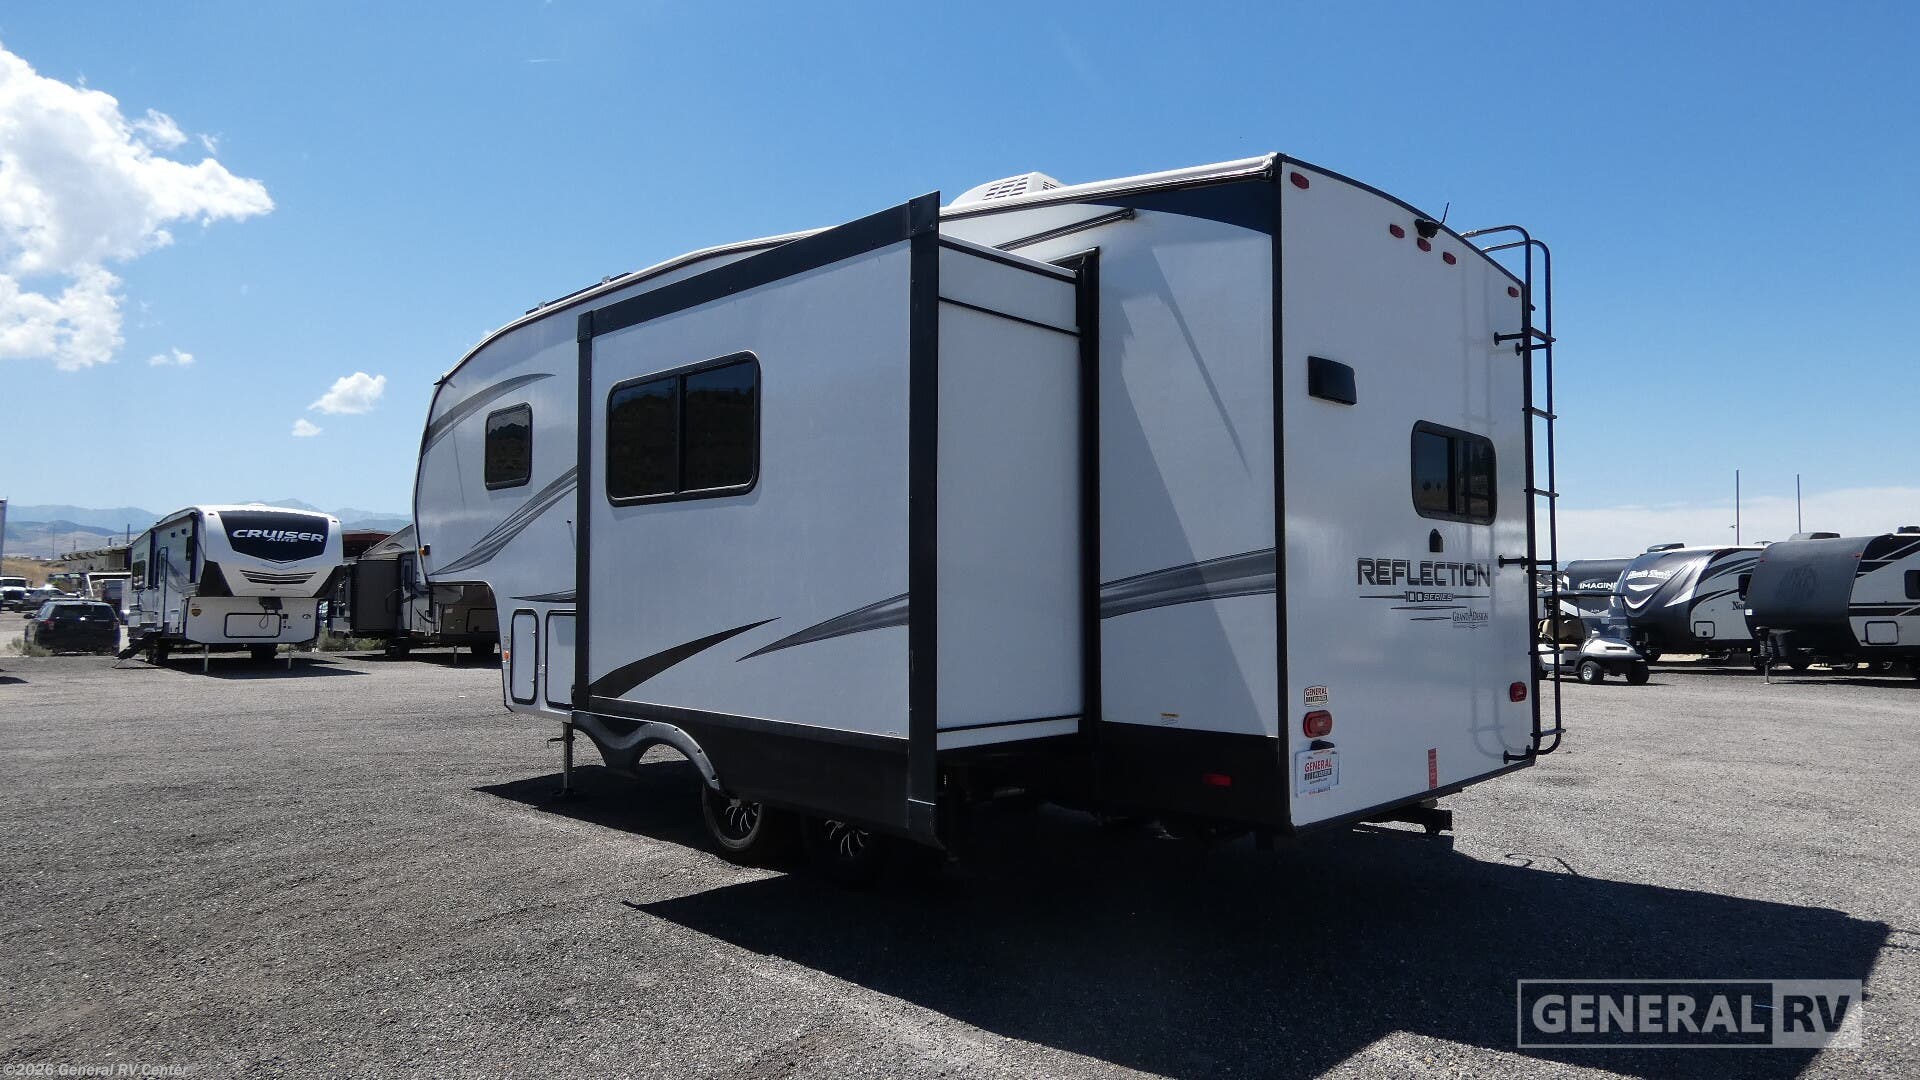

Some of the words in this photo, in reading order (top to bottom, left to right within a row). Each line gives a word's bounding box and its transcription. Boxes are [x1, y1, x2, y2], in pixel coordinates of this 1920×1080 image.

[232, 529, 325, 543] CRUISER
[1357, 557, 1491, 587] REFLECTION
[1305, 687, 1327, 696] GENERAL
[1304, 758, 1332, 772] GENERAL
